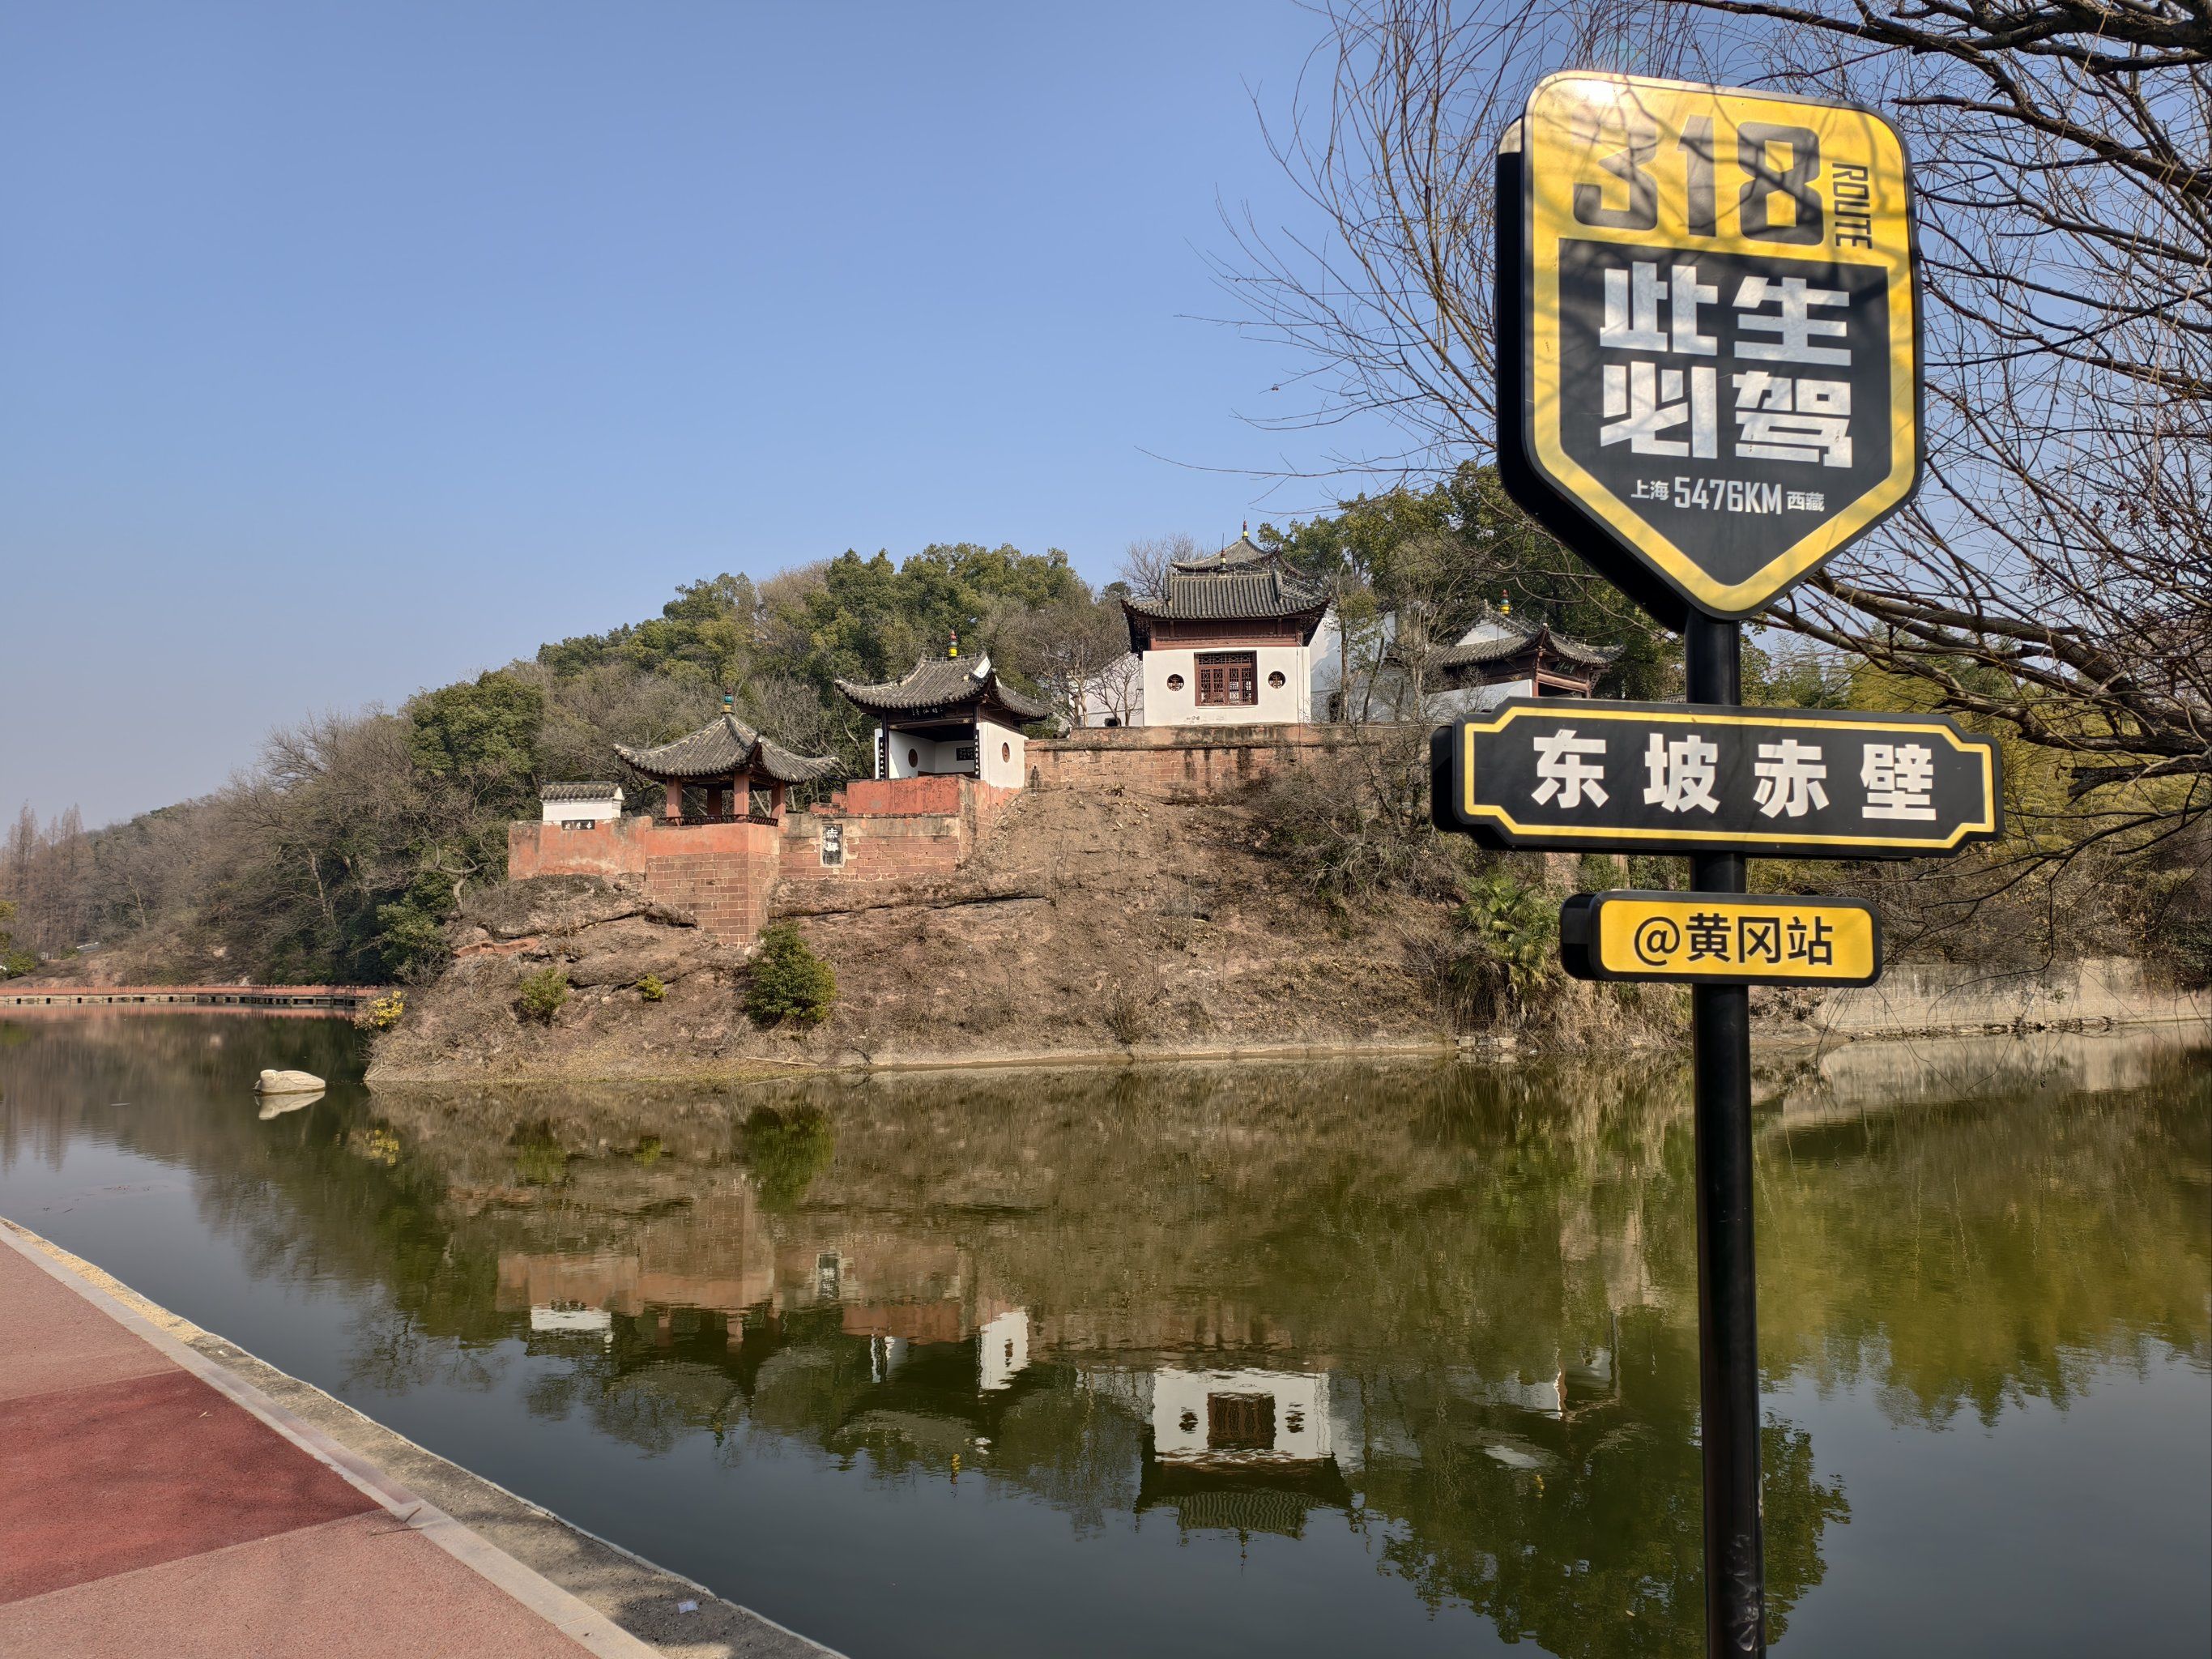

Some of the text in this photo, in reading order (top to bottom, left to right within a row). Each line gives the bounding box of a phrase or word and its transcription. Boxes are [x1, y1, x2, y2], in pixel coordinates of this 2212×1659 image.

[1572, 113, 1824, 245] 318
[1832, 163, 1873, 249] ROUTE
[1600, 261, 1852, 366] 此生
[1600, 361, 1853, 468] 必驾
[1630, 479, 1670, 501] 上海
[1674, 476, 1782, 515] 5476KM
[1786, 490, 1825, 512] 西藏
[1531, 729, 1937, 821] 东坡赤壁
[1633, 912, 1834, 966] @黄冈站
